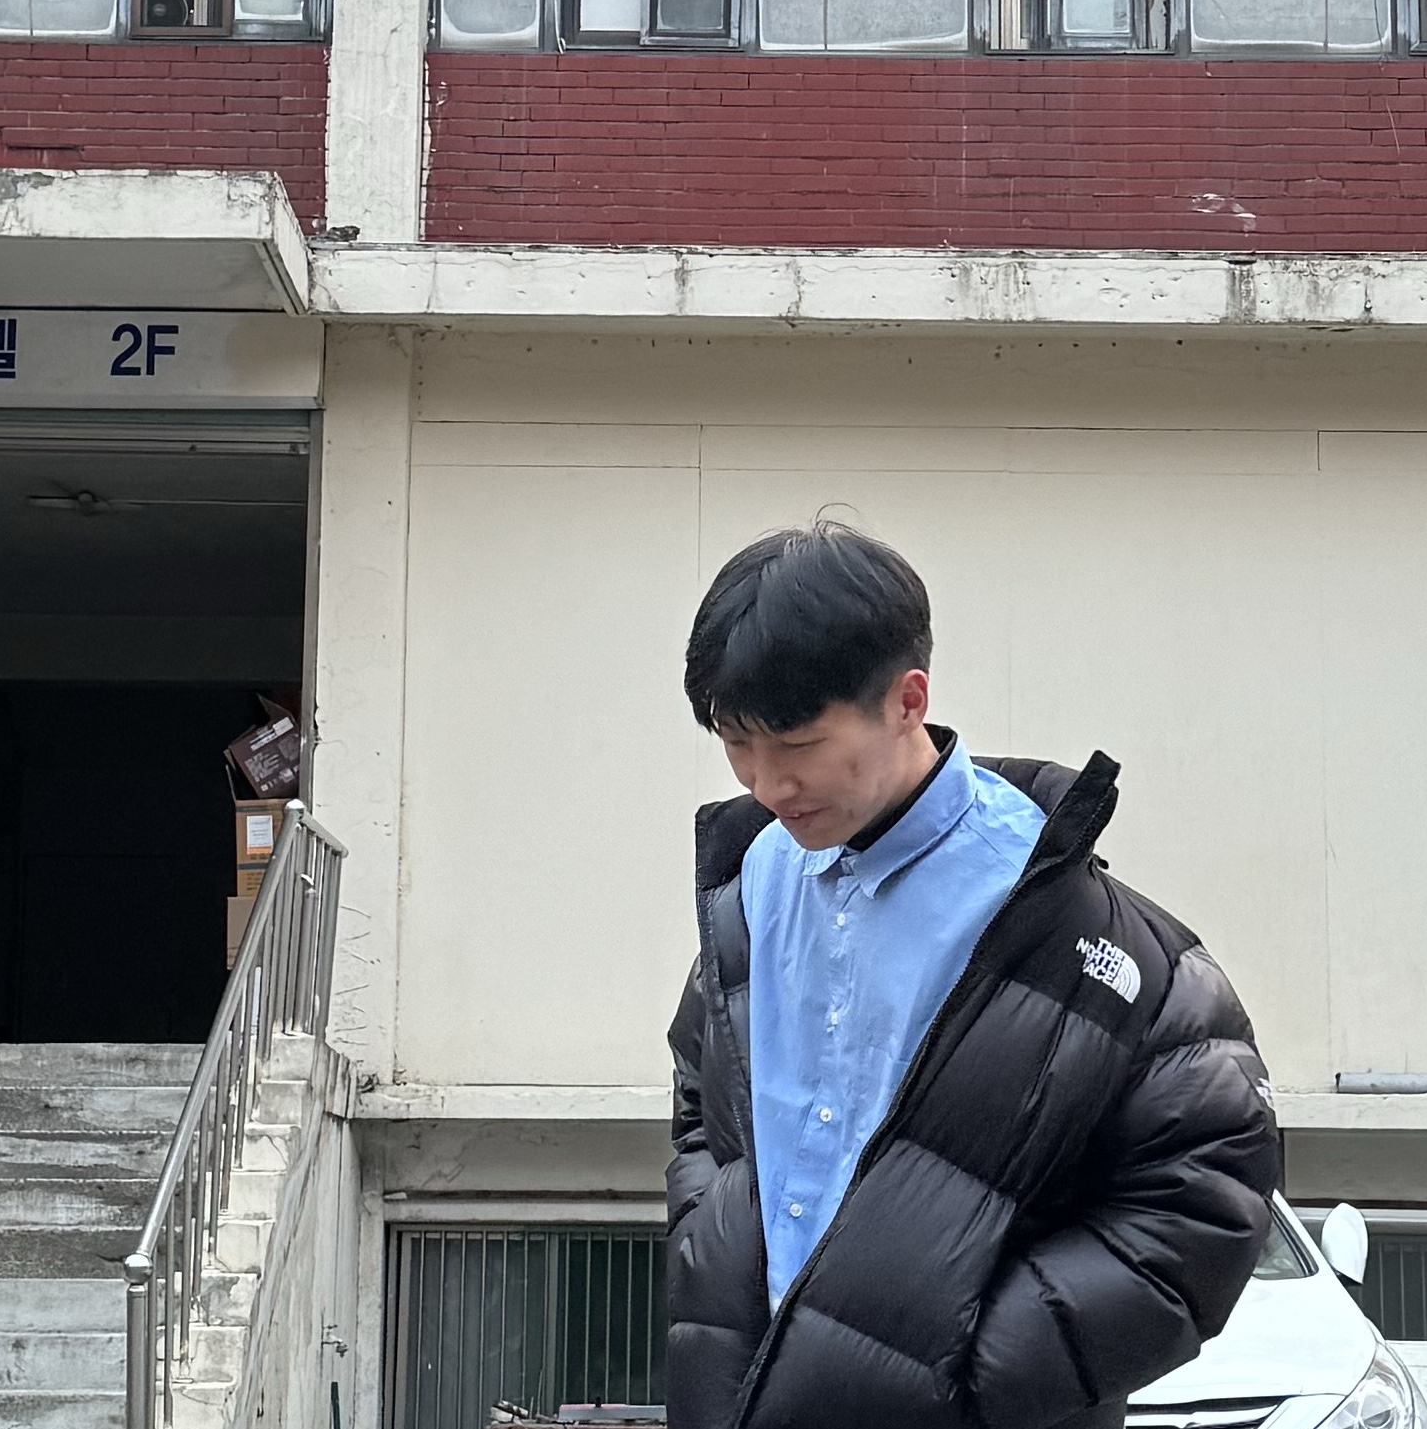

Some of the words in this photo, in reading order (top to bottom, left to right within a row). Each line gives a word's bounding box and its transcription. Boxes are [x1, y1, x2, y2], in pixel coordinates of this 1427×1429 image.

[110, 323, 180, 378] 2F
[1076, 937, 1123, 976] NORTH
[1098, 937, 1125, 962] THE
